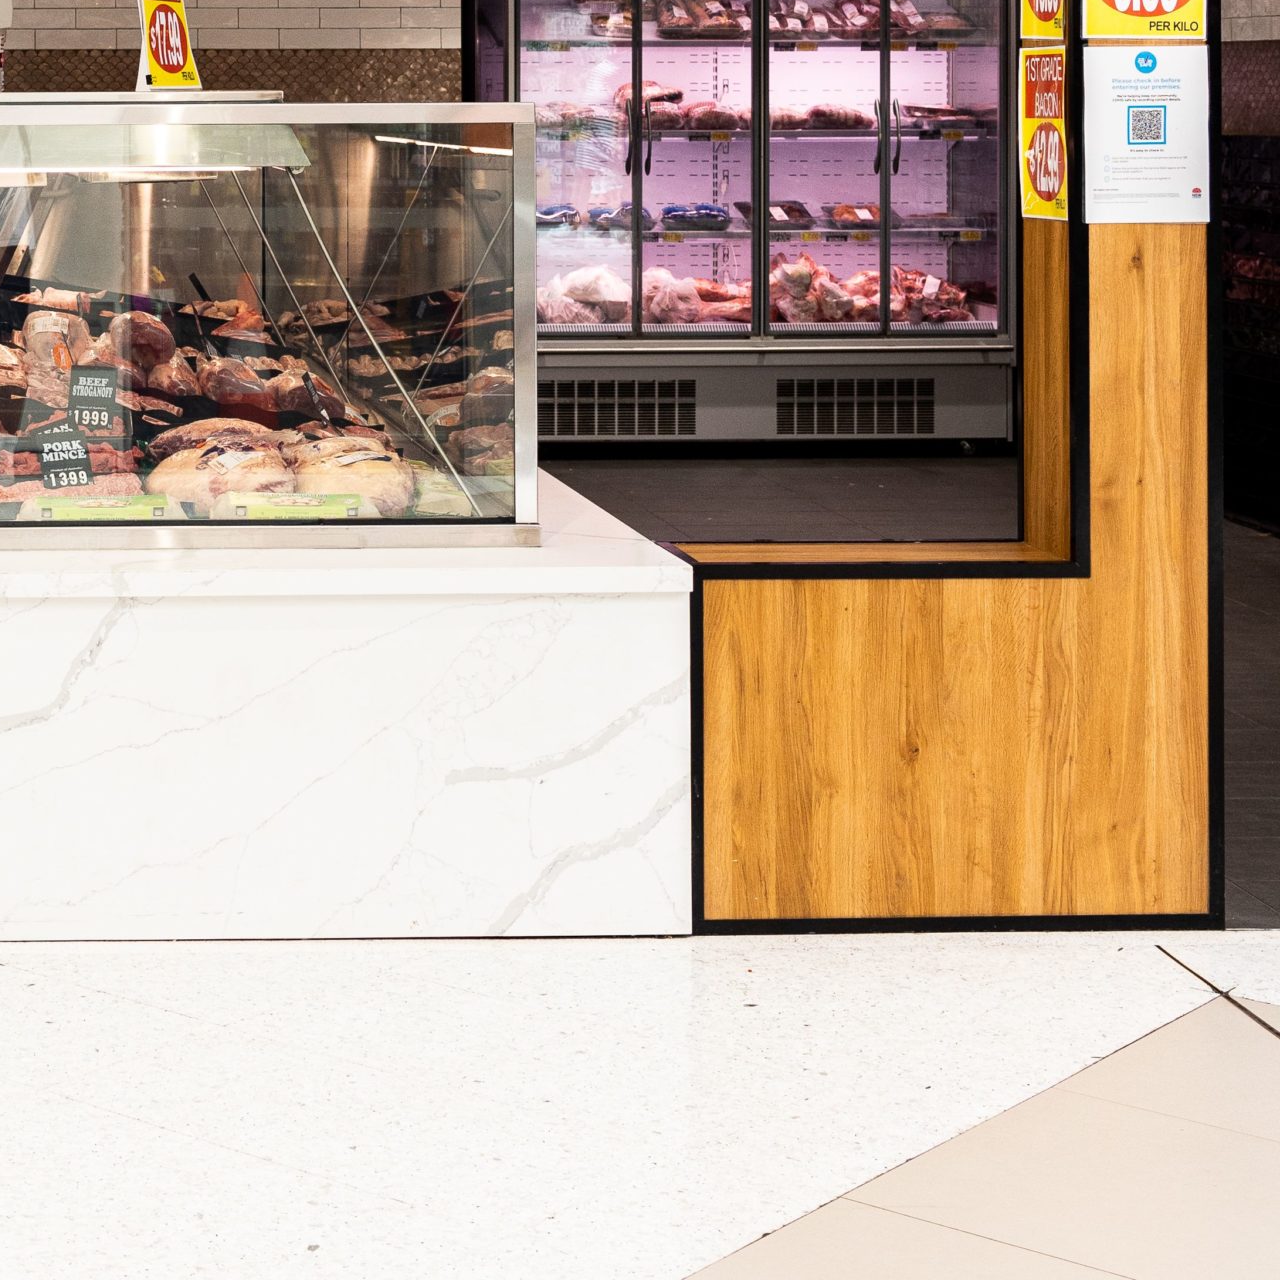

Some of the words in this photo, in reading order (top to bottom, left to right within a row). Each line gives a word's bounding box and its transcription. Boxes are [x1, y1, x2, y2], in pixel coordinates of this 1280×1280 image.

[1149, 21, 1170, 31] PER
[1173, 21, 1199, 32] KILO
[151, 11, 184, 66] $17.99
[1026, 57, 1040, 81] 1ST
[1040, 57, 1062, 81] GRADE
[1035, 92, 1059, 117] BACON
[79, 376, 109, 386] BEEF
[73, 385, 114, 398] STROGANOFF
[42, 440, 84, 452] PORK
[42, 449, 87, 462] MINCE
